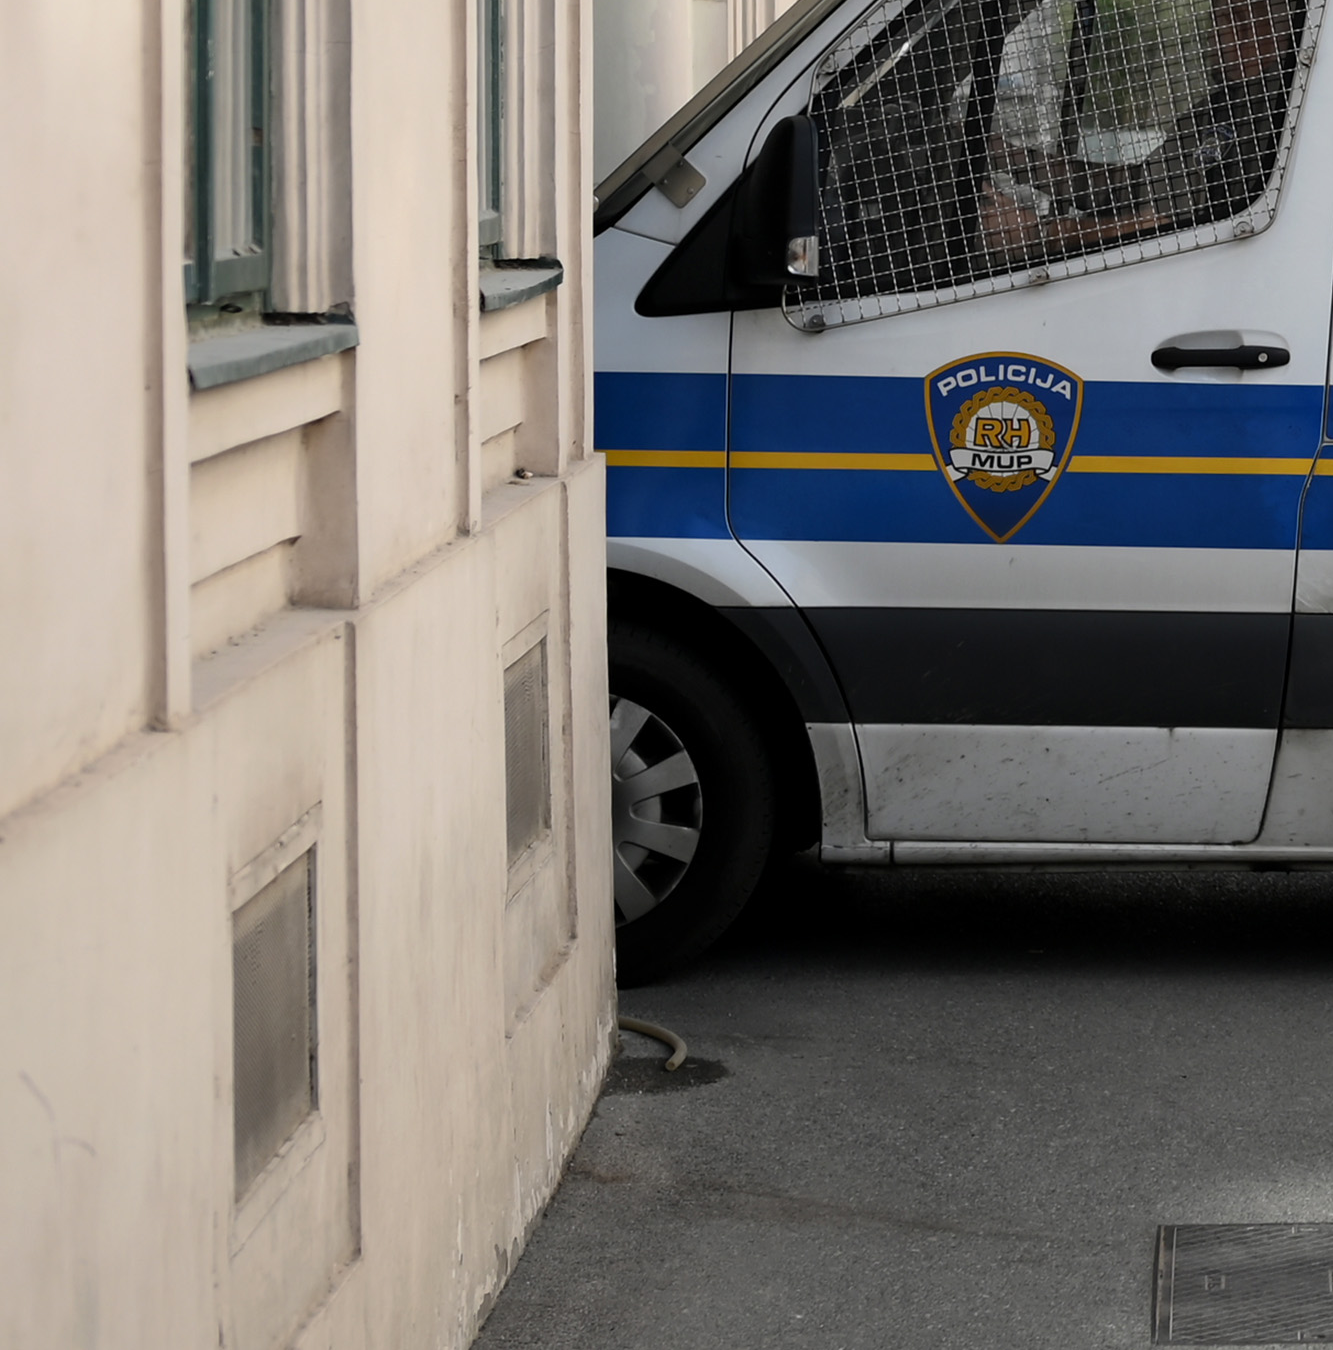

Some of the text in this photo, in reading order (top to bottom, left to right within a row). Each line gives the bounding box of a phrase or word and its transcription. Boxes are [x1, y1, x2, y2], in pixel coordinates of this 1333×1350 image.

[937, 363, 1071, 401] POLICIJA
[974, 417, 1031, 448] RH
[971, 453, 1033, 469] MUP
